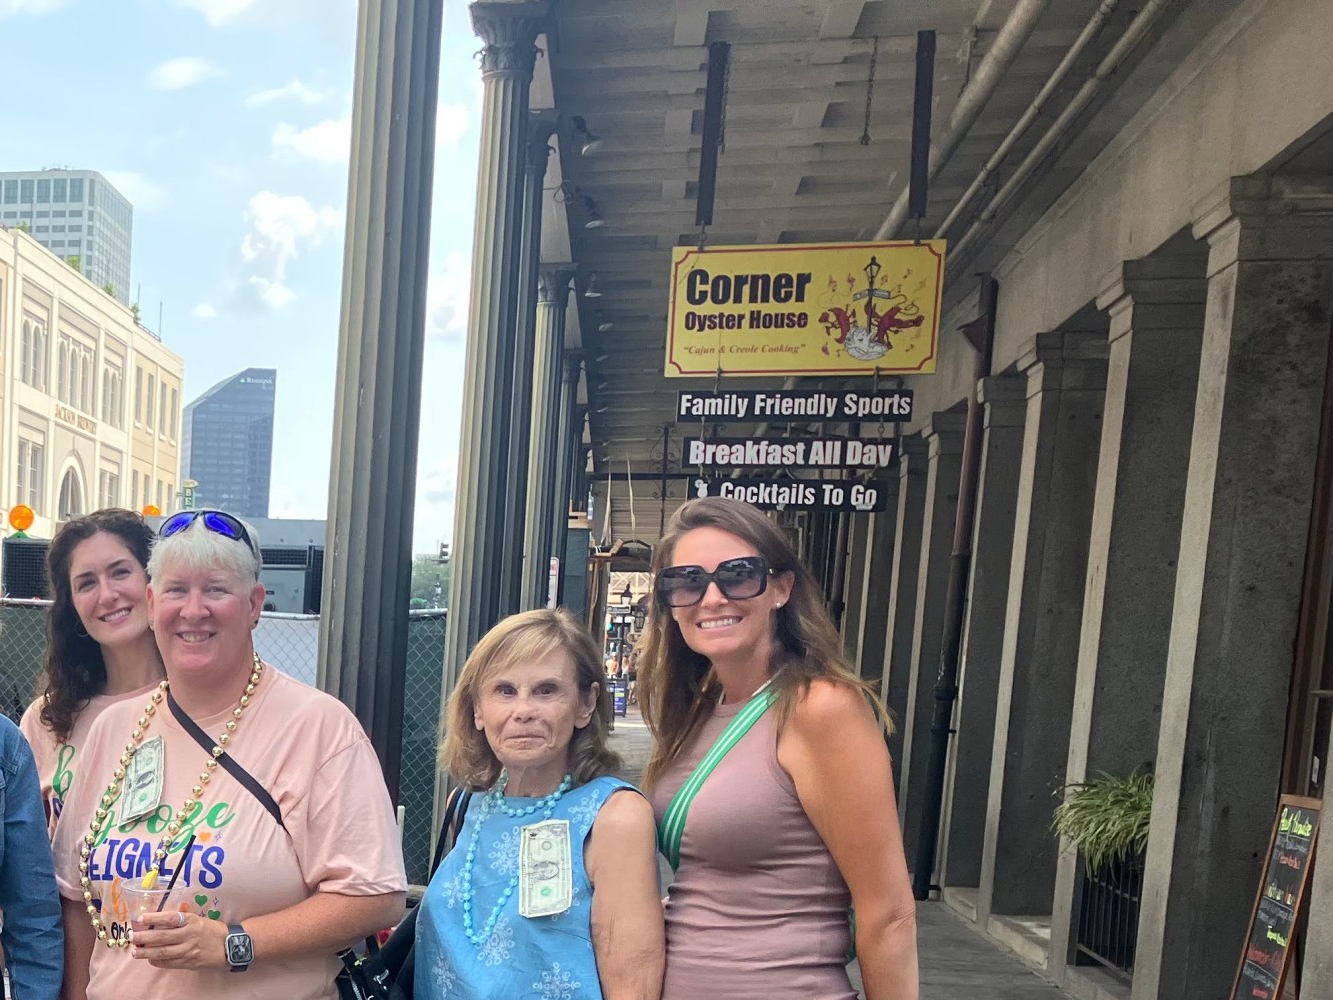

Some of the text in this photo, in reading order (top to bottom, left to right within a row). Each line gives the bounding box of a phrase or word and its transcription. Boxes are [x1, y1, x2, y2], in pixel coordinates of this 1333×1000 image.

[685, 268, 812, 306] Corner
[684, 310, 808, 333] Oyster House
[718, 345, 727, 354] &
[729, 344, 758, 355] Creole
[680, 392, 911, 418] Family Friendly Sports
[688, 440, 893, 468] Breakfast All Day
[719, 481, 877, 508] Cocktails To Go
